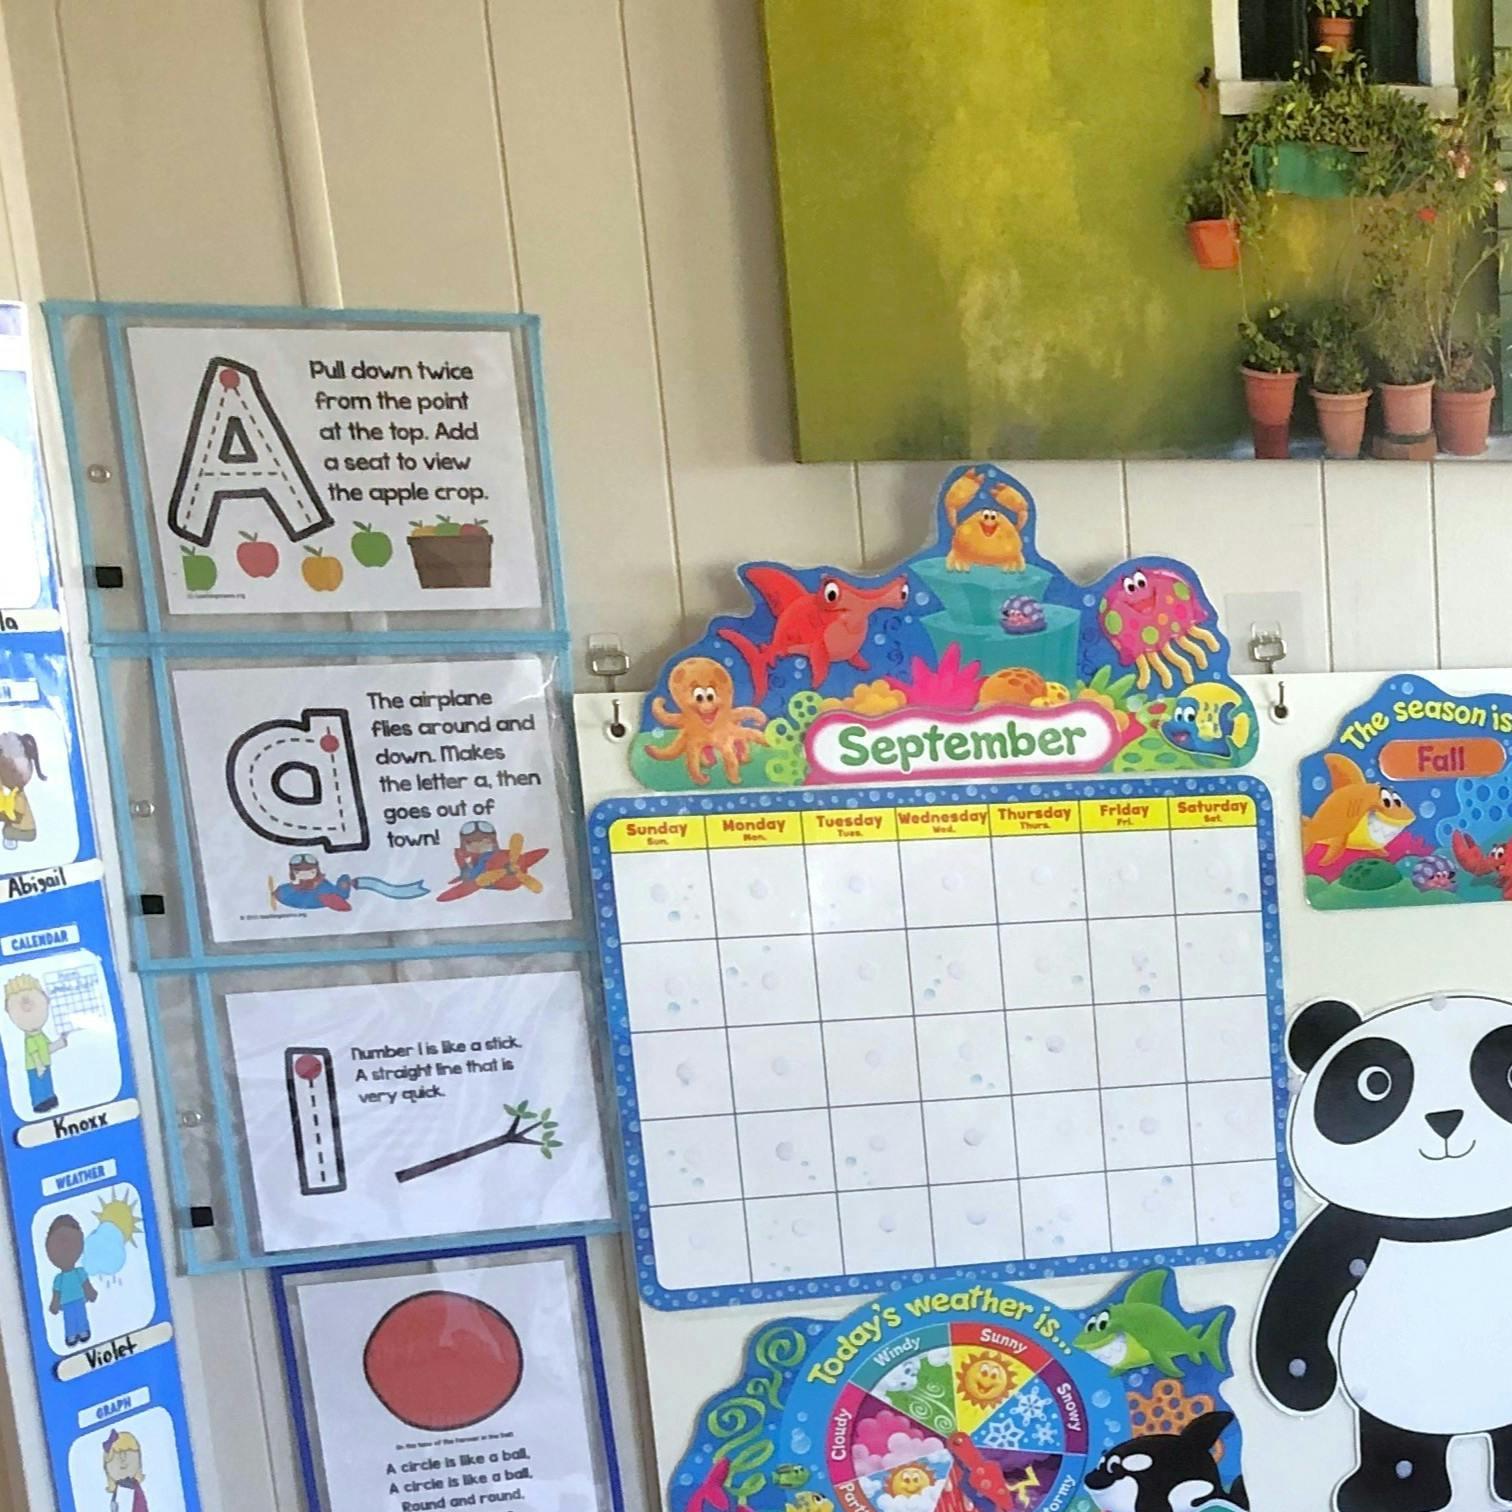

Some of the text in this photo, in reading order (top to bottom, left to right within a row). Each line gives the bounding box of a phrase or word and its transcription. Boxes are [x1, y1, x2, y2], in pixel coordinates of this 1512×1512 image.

[309, 360, 474, 380] Pull down twice
[315, 391, 469, 414] from the point
[320, 421, 479, 445] at the top. Add
[167, 357, 334, 547] A
[324, 452, 471, 470] a seat to view
[328, 482, 489, 505] the apple crop.
[367, 690, 492, 711] The airplane
[372, 714, 535, 737] flies around and
[1340, 712, 1390, 750] The
[1393, 700, 1487, 727] season
[376, 744, 505, 764] down. Makes
[838, 723, 1087, 772] September
[1417, 746, 1465, 772] Fall
[379, 770, 541, 792] the letter a, then
[384, 798, 495, 824] goes out of
[898, 809, 987, 826] Wednesday
[998, 807, 1071, 822] Thursday
[1100, 804, 1149, 818] Friday
[1178, 801, 1248, 816] Saturday
[627, 821, 688, 837] Sunday
[723, 818, 786, 833] Monday
[816, 813, 882, 830] Tuesday
[387, 829, 440, 848] town!
[8, 868, 67, 898] Abigail
[11, 930, 68, 950] CALENDAR
[351, 1045, 414, 1060] Number
[426, 1041, 438, 1055] is
[441, 1040, 465, 1054] like
[470, 1041, 481, 1051] a
[355, 1058, 514, 1082] A straight line that is
[358, 1090, 397, 1104] very
[54, 1112, 108, 1138] Knoxx
[55, 1166, 106, 1190] WEATHER
[807, 1285, 1072, 1385] Today's weather is...
[979, 1328, 1028, 1354] Sunny
[85, 1339, 138, 1370] Violet
[873, 1337, 921, 1367] Windy
[96, 1398, 132, 1420] GRAPH
[1057, 1382, 1081, 1432] Snowy
[831, 1408, 852, 1460] Cloudy
[402, 1497, 445, 1512] Round
[450, 1494, 476, 1508] and
